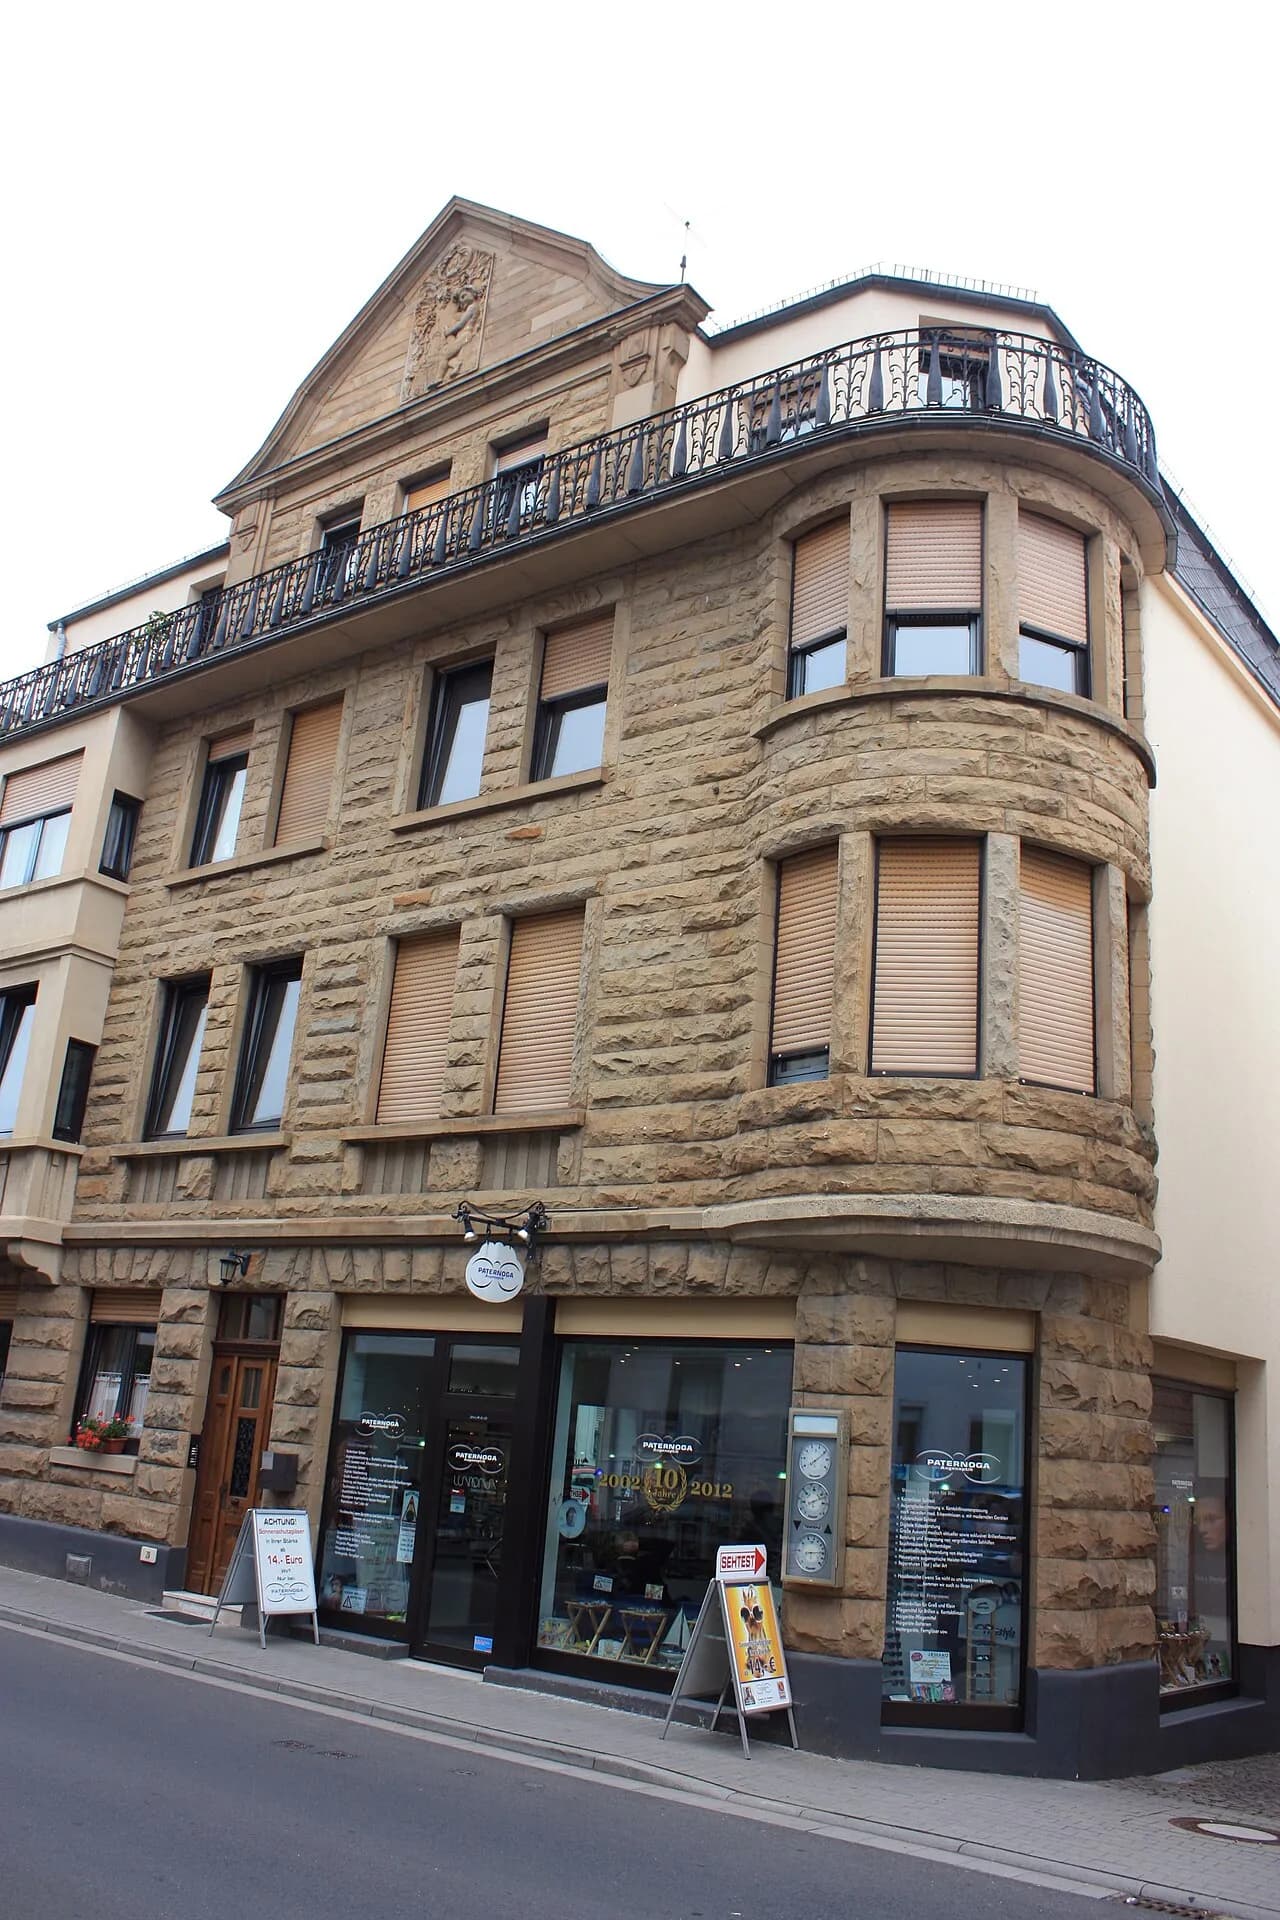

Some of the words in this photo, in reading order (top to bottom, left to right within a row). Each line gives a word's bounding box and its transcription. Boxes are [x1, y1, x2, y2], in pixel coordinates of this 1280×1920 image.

[478, 1266, 514, 1278] PATERNOGA
[361, 1418, 400, 1427] PATERNOGA
[642, 1441, 693, 1452] PATERNOGA
[455, 1451, 498, 1461] PATERNOGA
[927, 1459, 991, 1470] PATERNOGA
[600, 1474, 641, 1491] 2002
[654, 1468, 679, 1489] 10
[651, 1489, 677, 1500] Jahre
[690, 1481, 733, 1499] 2012
[263, 1518, 297, 1526] ACHTUNG!
[285, 1555, 303, 1565] Euro
[721, 1555, 755, 1569] SEHTEST
